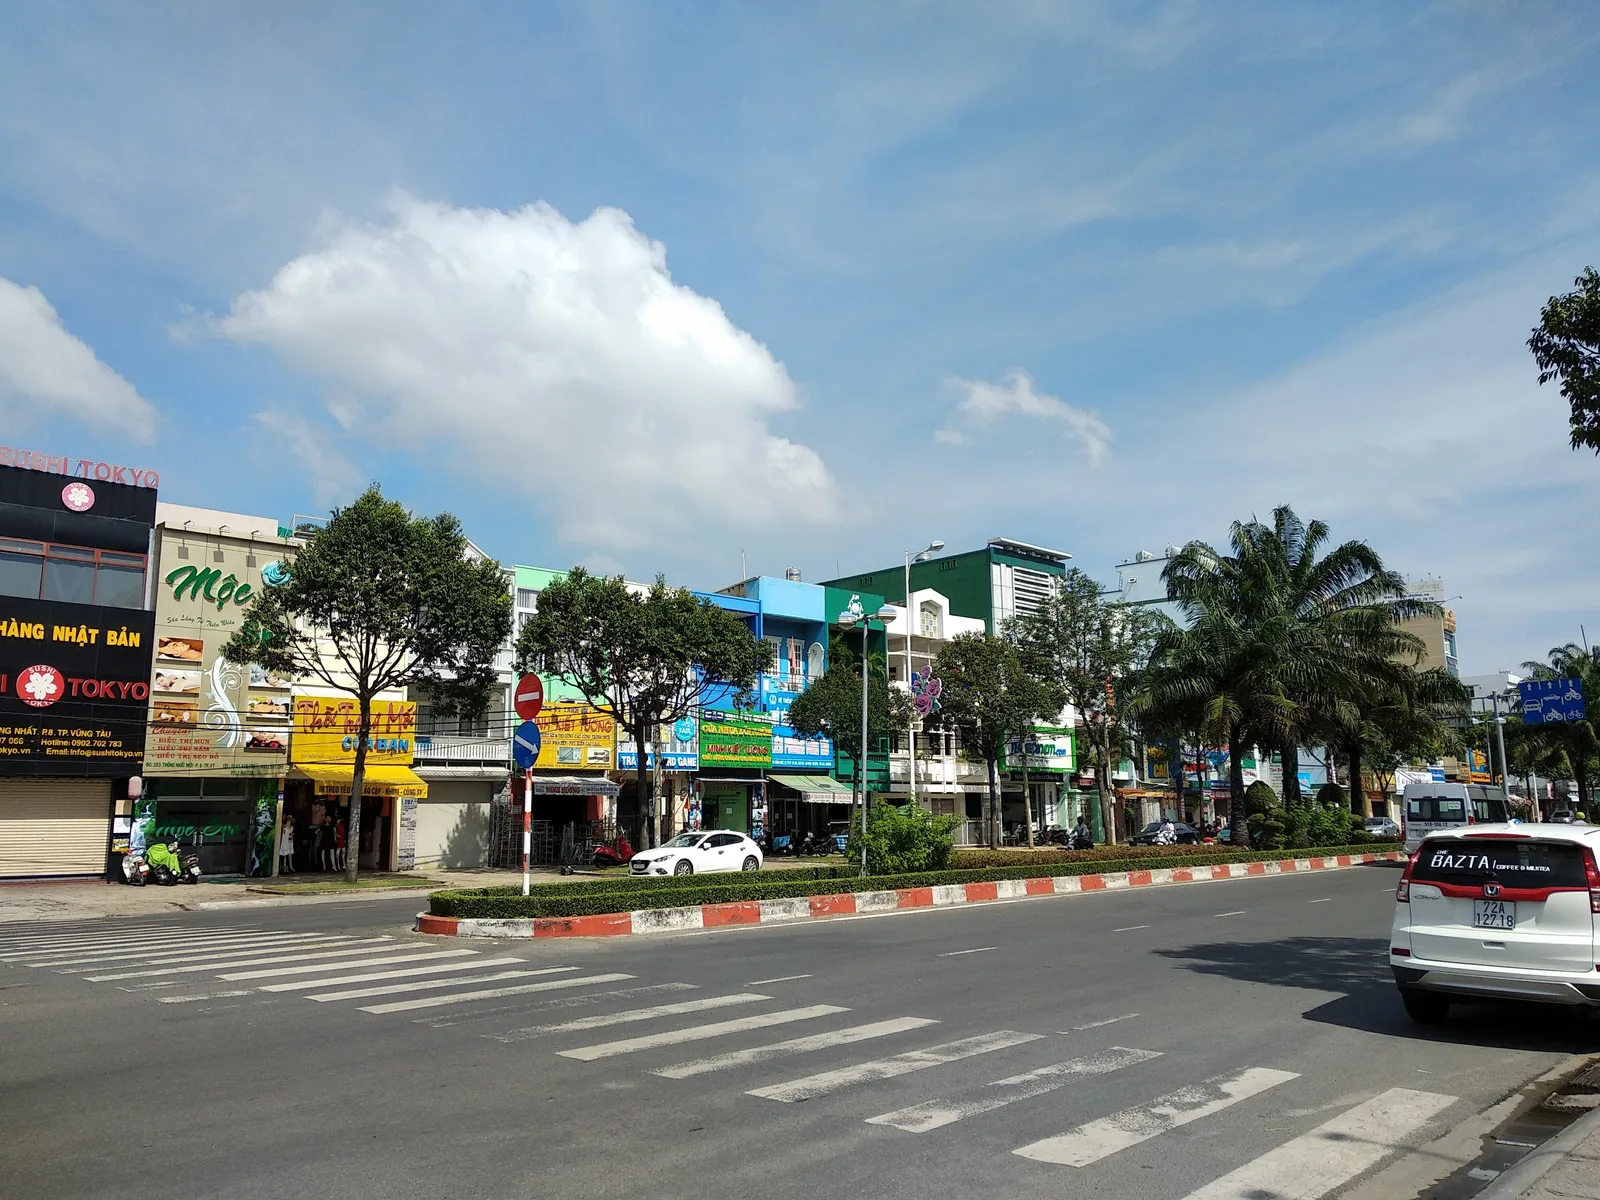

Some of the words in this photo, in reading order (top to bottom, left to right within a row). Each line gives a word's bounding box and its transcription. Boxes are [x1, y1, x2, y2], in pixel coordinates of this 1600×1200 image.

[0, 446, 68, 475] SUSHI
[80, 460, 160, 488] TOKYO
[165, 565, 255, 611] Mộc
[0, 618, 45, 640] HÀNG
[52, 625, 99, 647] NHẬT
[106, 626, 140, 648] BẢN
[28, 665, 56, 674] SUSHI
[68, 678, 149, 700] TOKYO
[70, 729, 94, 738] VŨNG
[96, 729, 112, 739] TÀU
[109, 740, 123, 748] 783
[677, 757, 697, 767] GAME
[1430, 855, 1489, 869] BAZTA
[1483, 901, 1505, 914] 72A
[1476, 913, 1514, 927] 127.18
